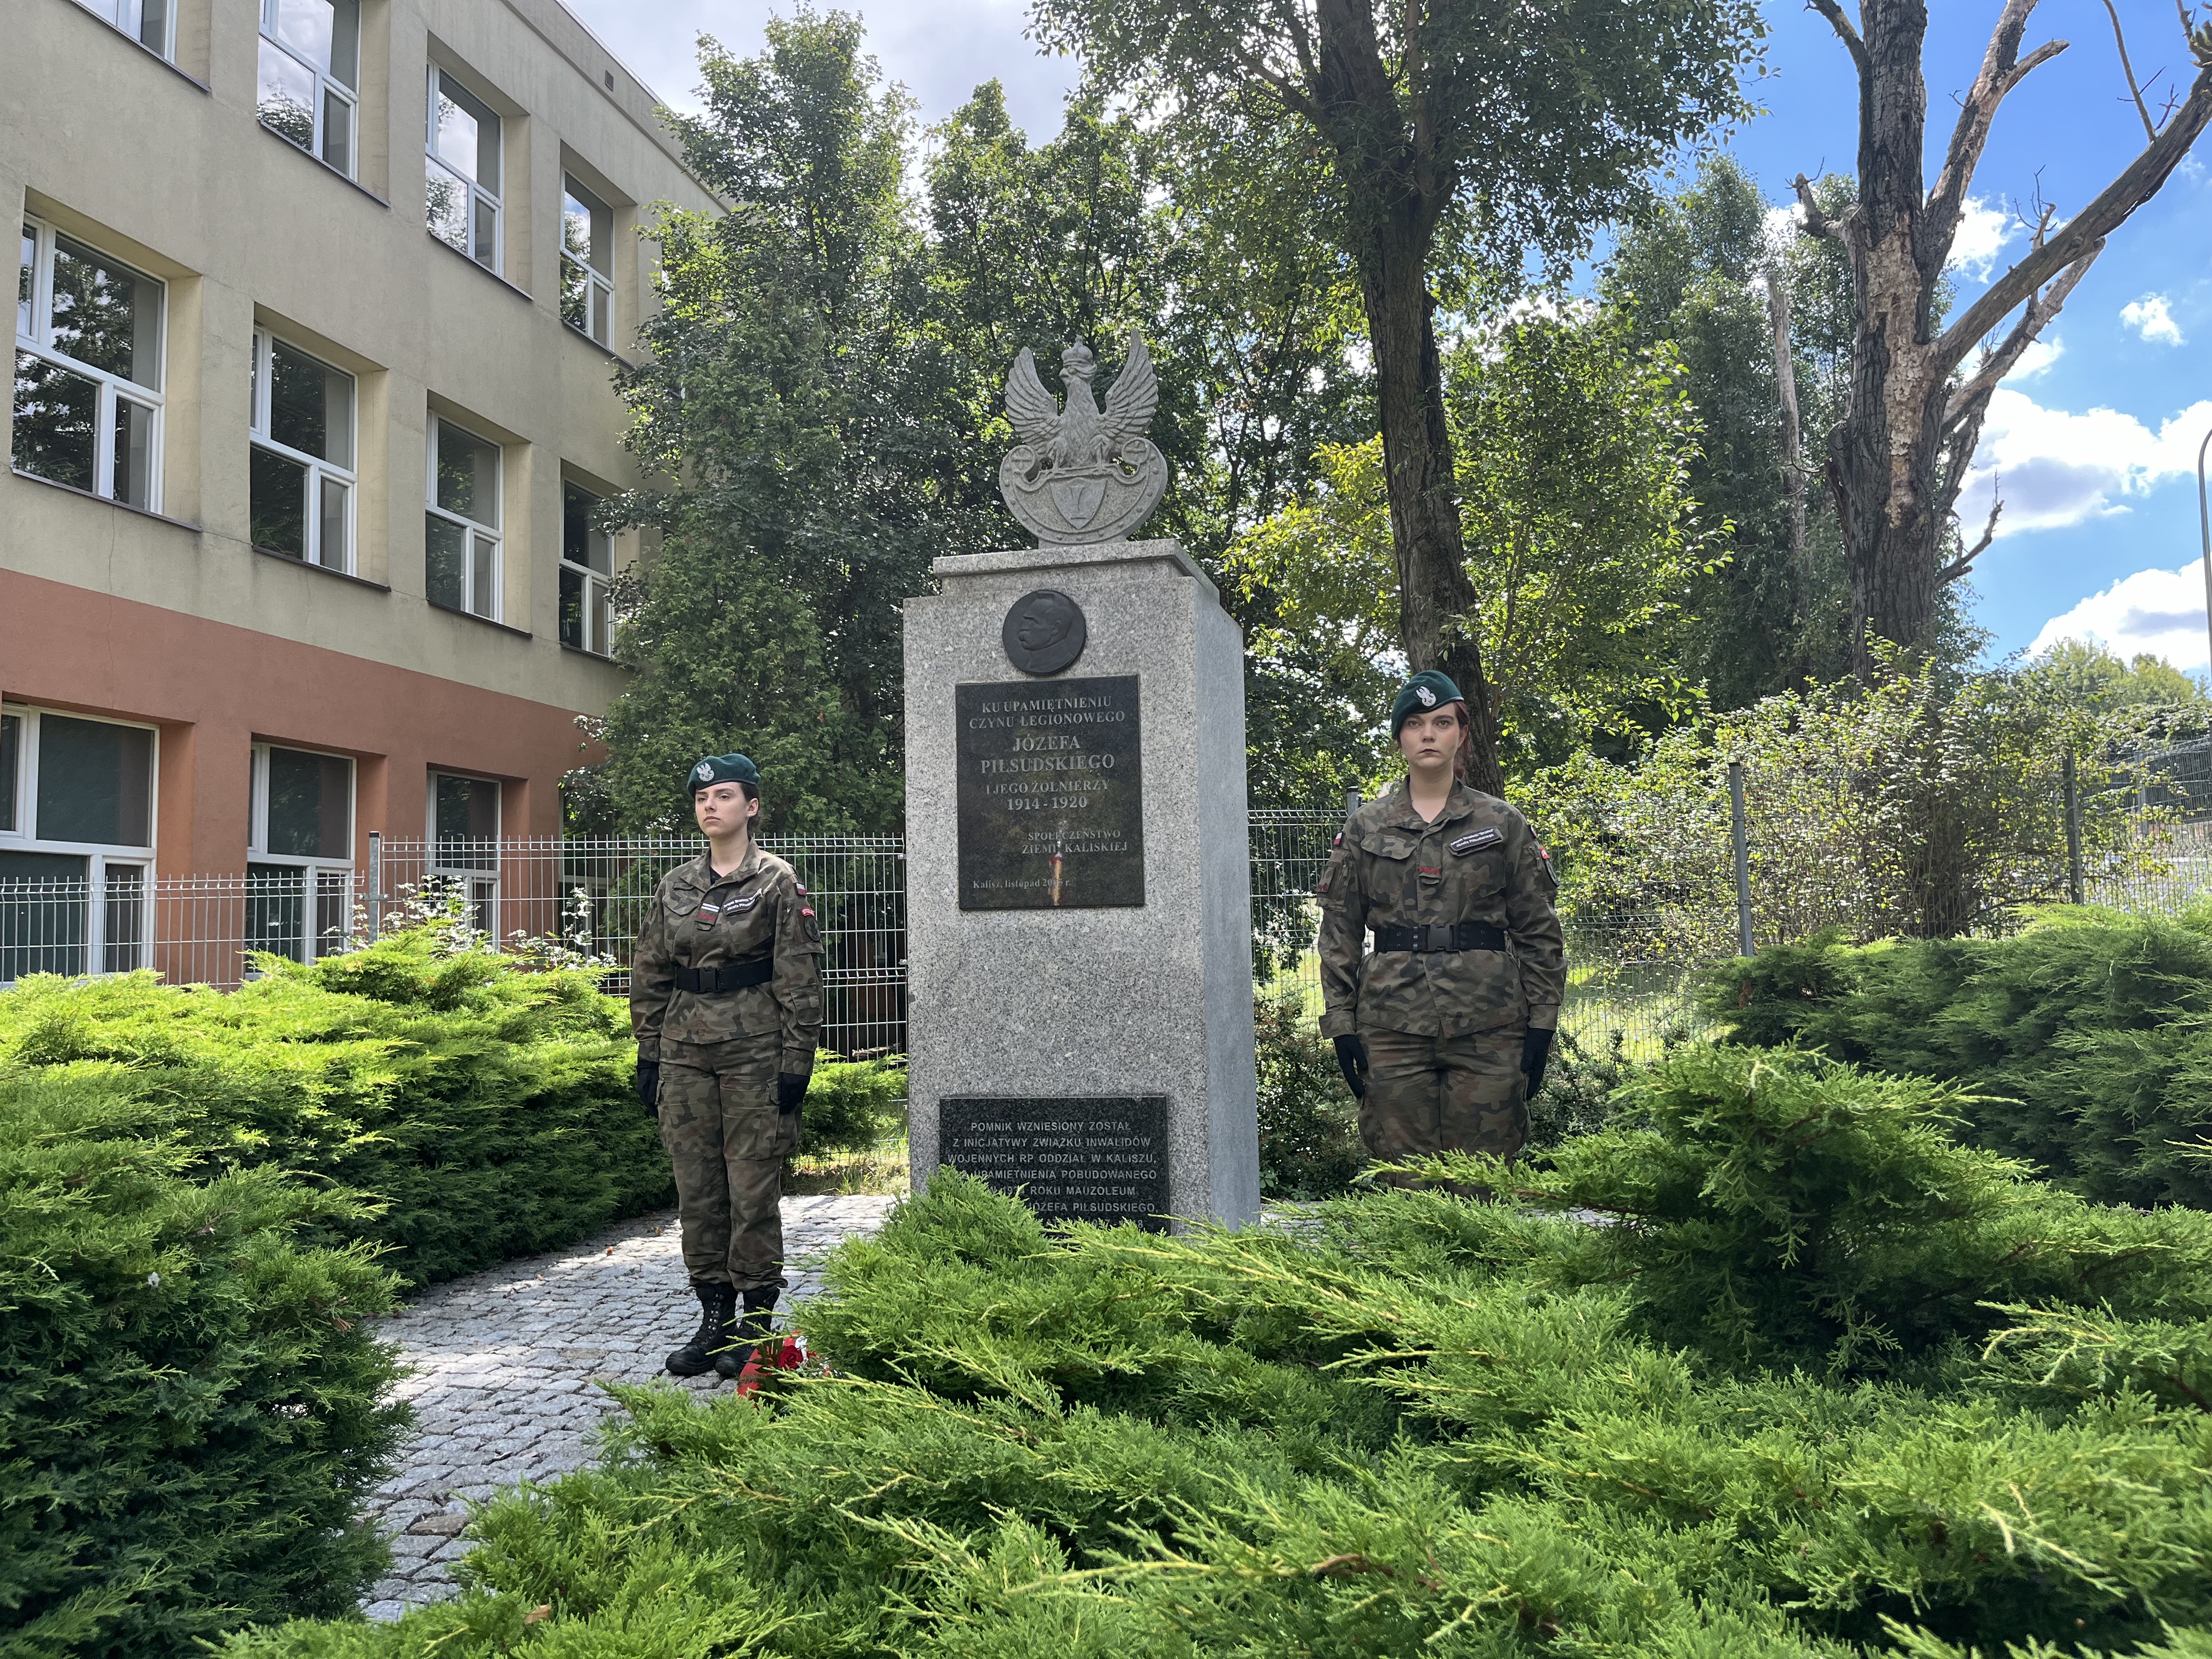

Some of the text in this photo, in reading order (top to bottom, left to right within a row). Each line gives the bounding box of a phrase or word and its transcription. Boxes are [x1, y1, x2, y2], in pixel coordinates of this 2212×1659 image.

[982, 696, 1112, 714] KU UPAMIĘTNIENIU
[969, 710, 1126, 730] CZYNU LEGIONOWEGO
[1013, 733, 1081, 752] JÓZEFA
[980, 754, 1115, 774] PIŁSUDSKIEGO
[986, 778, 1111, 795] I JEGO ŻOŁNIERZY
[1007, 797, 1040, 811] 1914
[1052, 795, 1088, 809] 1920
[1028, 829, 1121, 841] SPOŁECZEŃSTWO
[1022, 842, 1128, 854] ZIEMI KALISKIEJ
[973, 879, 1003, 889] Kalisz,
[1005, 878, 1041, 890] listopad
[1042, 878, 1063, 887] 205
[970, 1122, 1131, 1132] POMNIK WZNIESIONY ZOSTAŁ
[953, 1136, 1151, 1148] Z INICJATYWY ZWIĄZKU INWALIDÓW
[947, 1153, 1158, 1165] WOJENNYCH RP ODDZIAŁ W KALISZU,
[1061, 1170, 1158, 1180] POBUDOWANEGO
[1030, 1186, 1061, 1196] ROKU
[1065, 1186, 1136, 1196] MAUZOLEUM
[1073, 1202, 1159, 1214] PIŁSUDSKIEGO,
